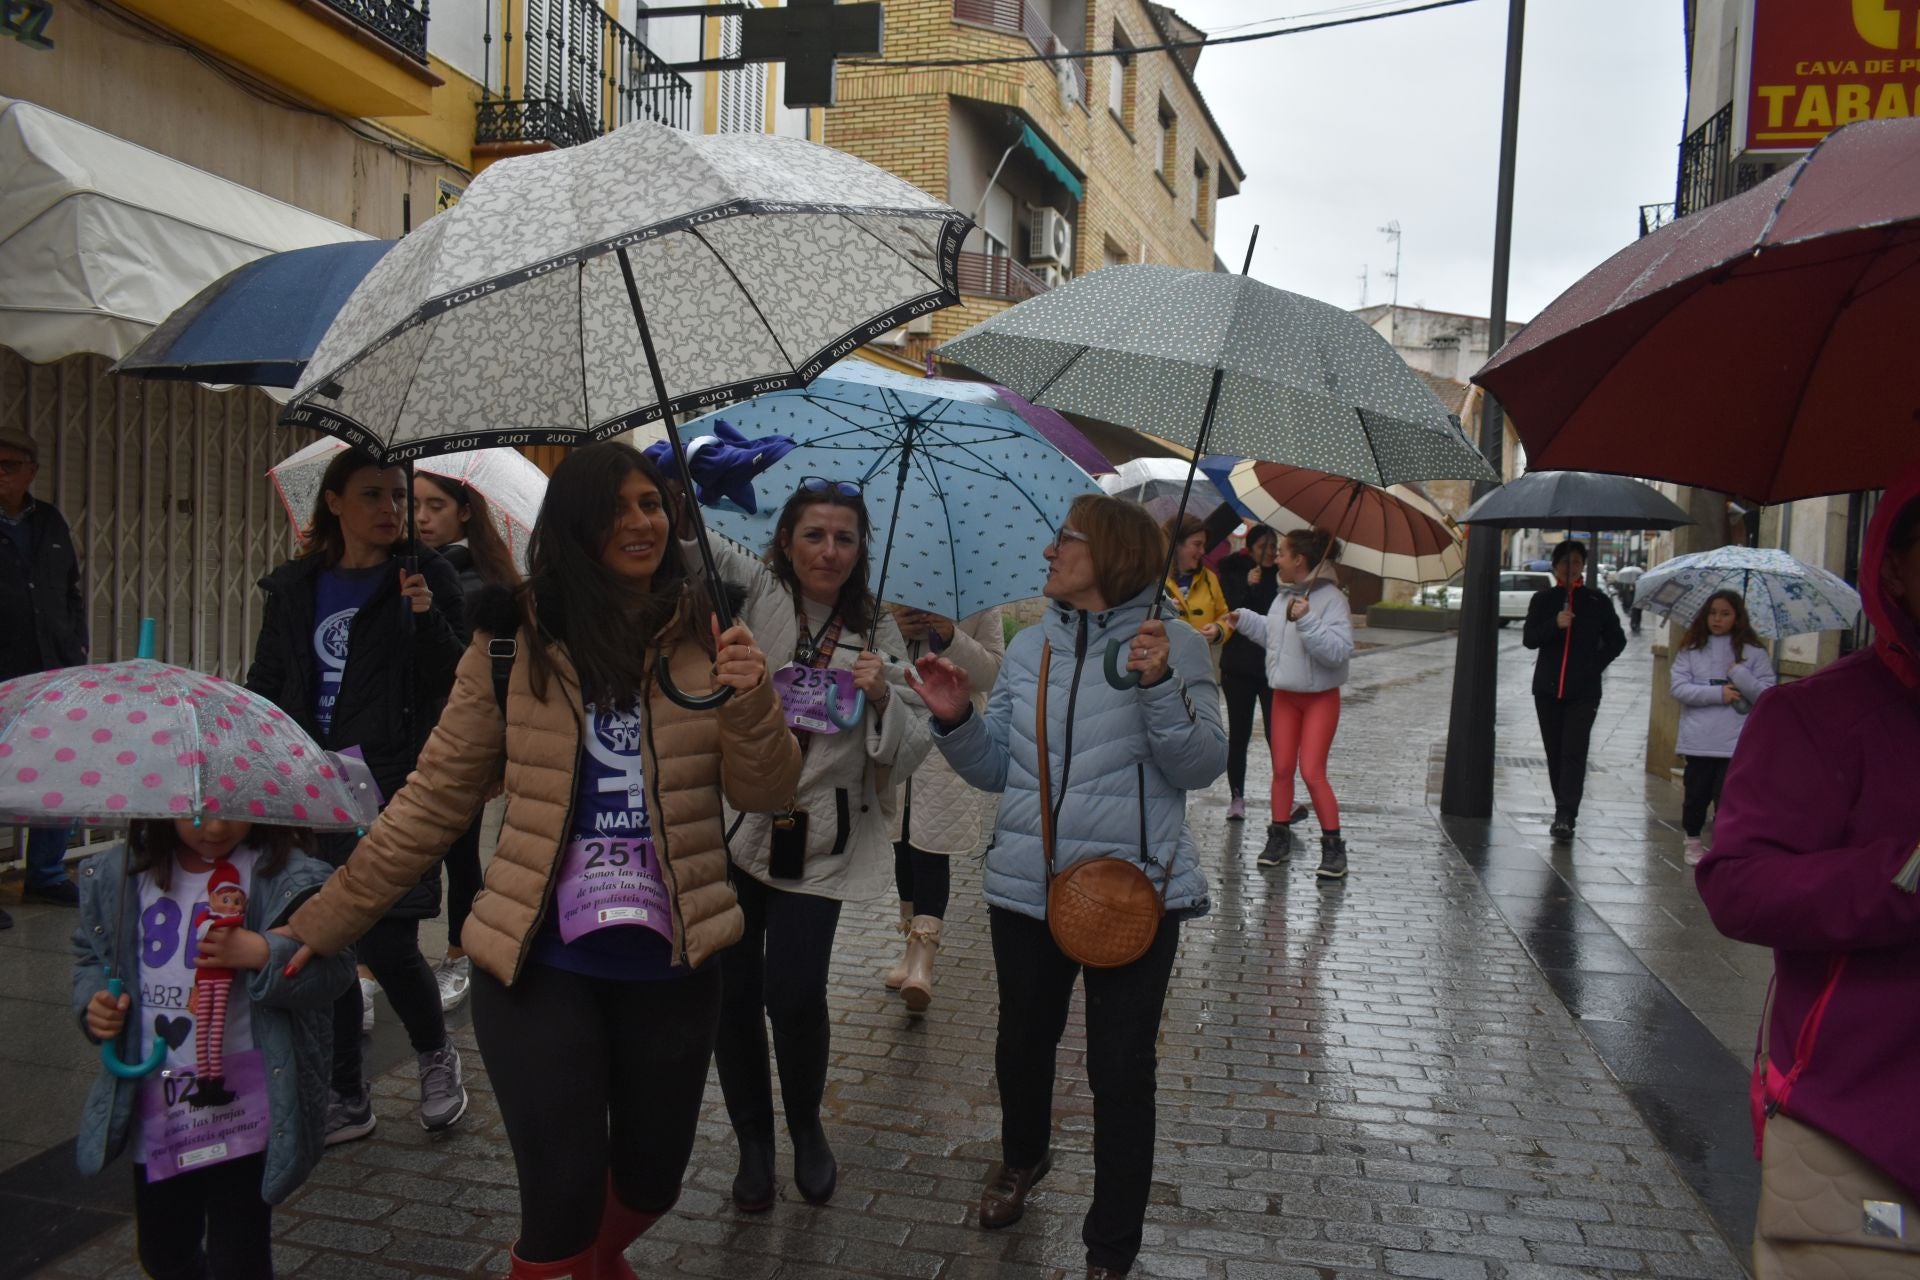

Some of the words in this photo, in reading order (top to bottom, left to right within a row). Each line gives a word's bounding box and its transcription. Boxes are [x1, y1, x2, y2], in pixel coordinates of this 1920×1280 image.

[1795, 60, 1859, 76] CAVA
[1864, 59, 1895, 74] DE
[1757, 83, 1920, 128] TABA
[686, 206, 739, 225] TOUS
[604, 228, 658, 249] TOUS
[524, 255, 577, 278] TOUS
[442, 282, 496, 307] TOUS
[792, 667, 838, 688] 255
[584, 841, 648, 870] 251
[618, 868, 634, 878] las
[576, 887, 587, 899] de
[589, 881, 617, 895] todas
[620, 881, 636, 890] las
[581, 902, 592, 912] no
[193, 1118, 209, 1129] las
[212, 1109, 246, 1125] brujas
